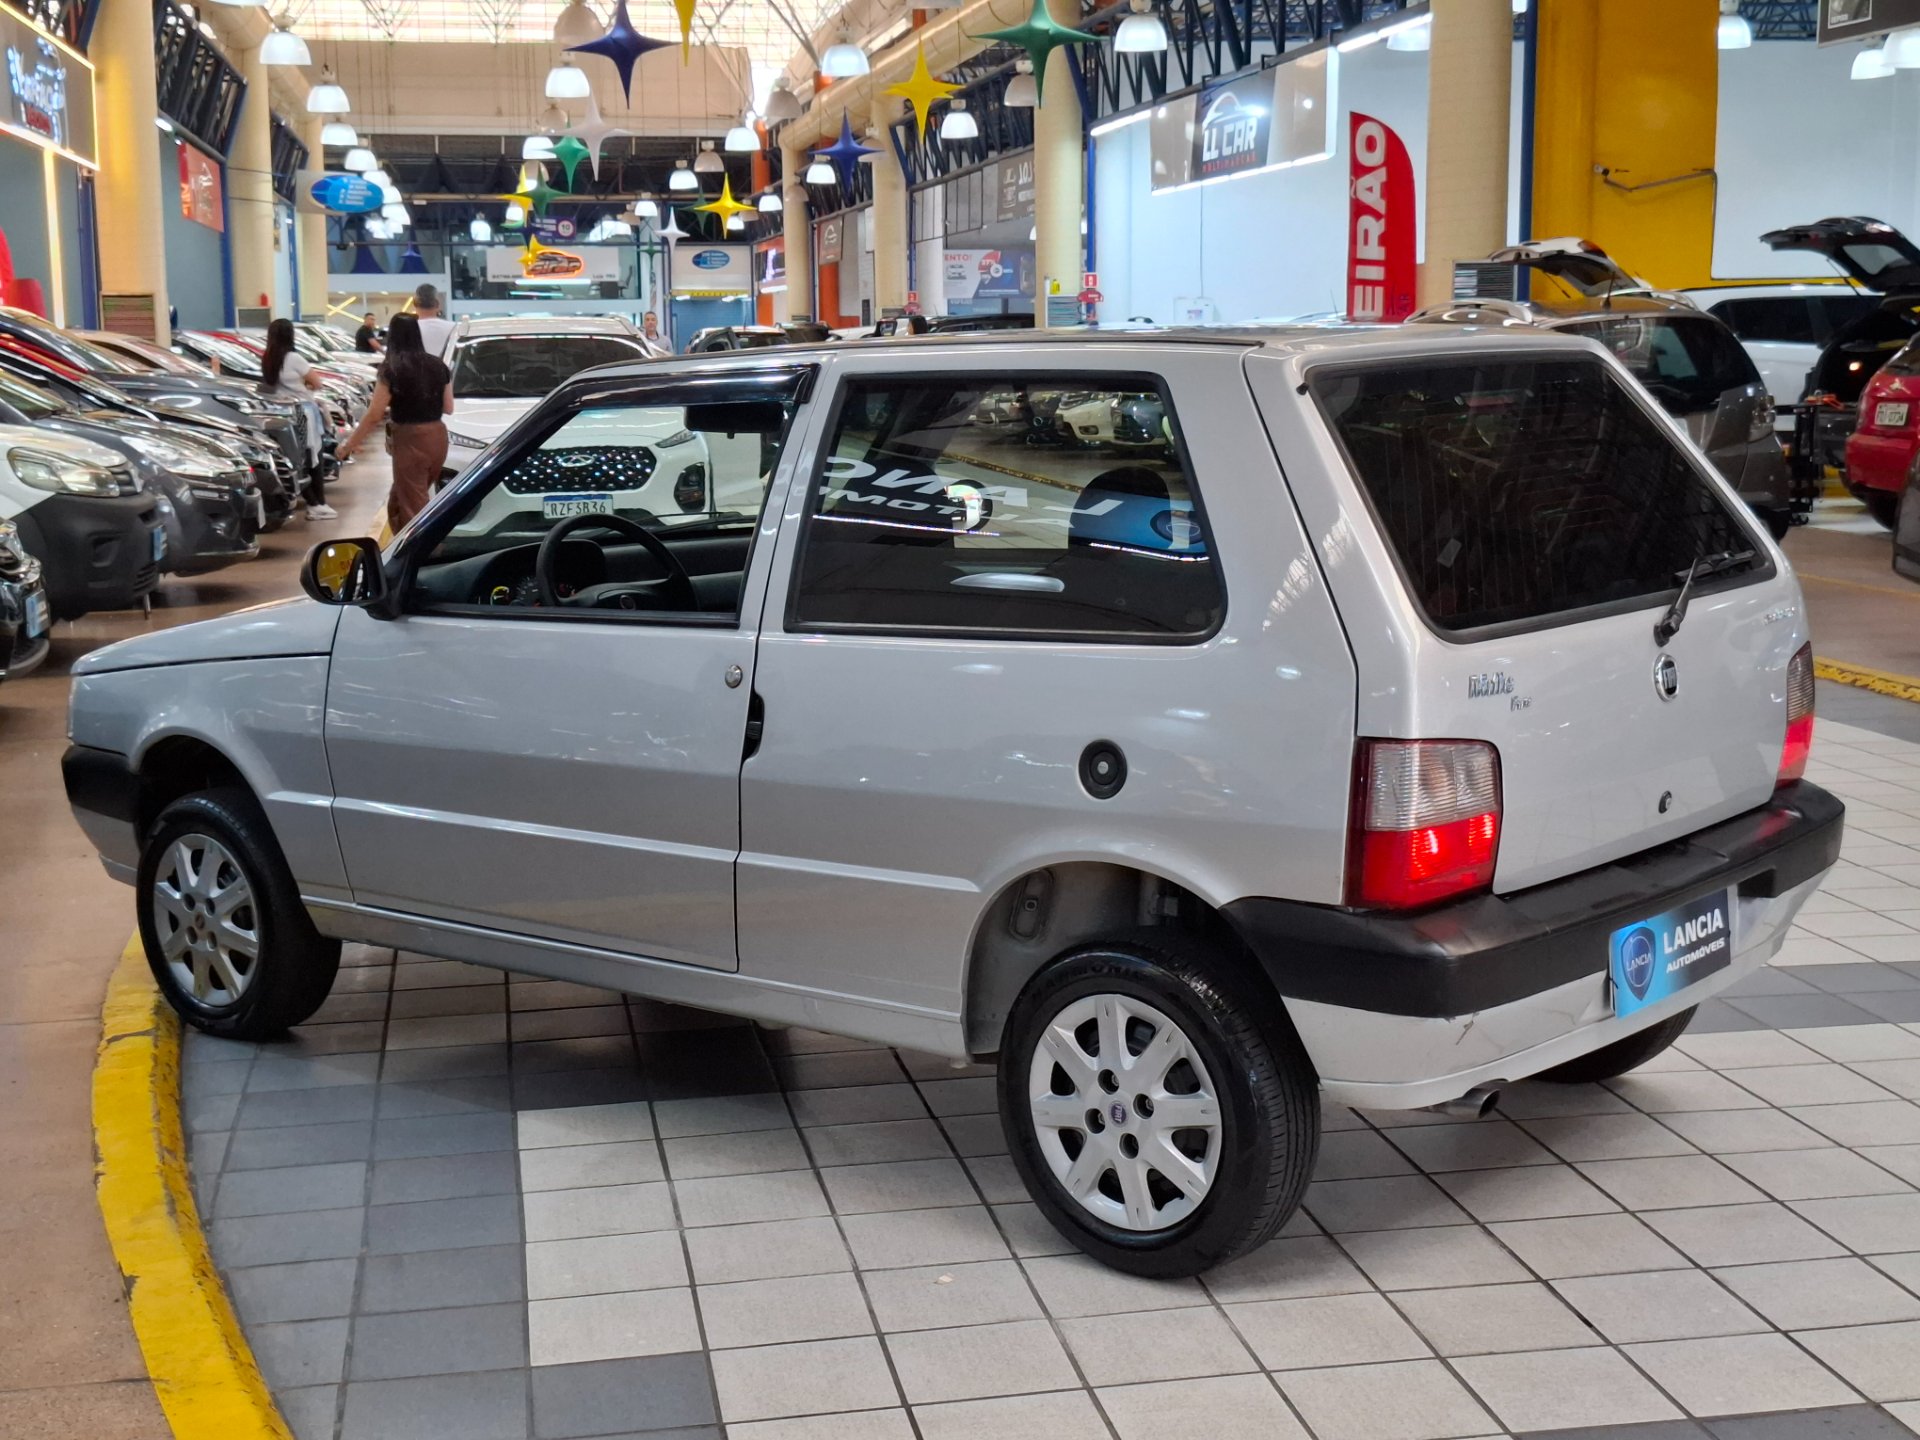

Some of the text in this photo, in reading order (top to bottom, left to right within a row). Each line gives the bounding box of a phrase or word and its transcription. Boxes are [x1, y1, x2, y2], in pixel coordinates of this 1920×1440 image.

[1222, 116, 1258, 157] CAR
[1663, 908, 1724, 955] LANCIA
[1626, 952, 1652, 972] LANCIA
[1665, 937, 1726, 974] AUTOMÓVEIS
